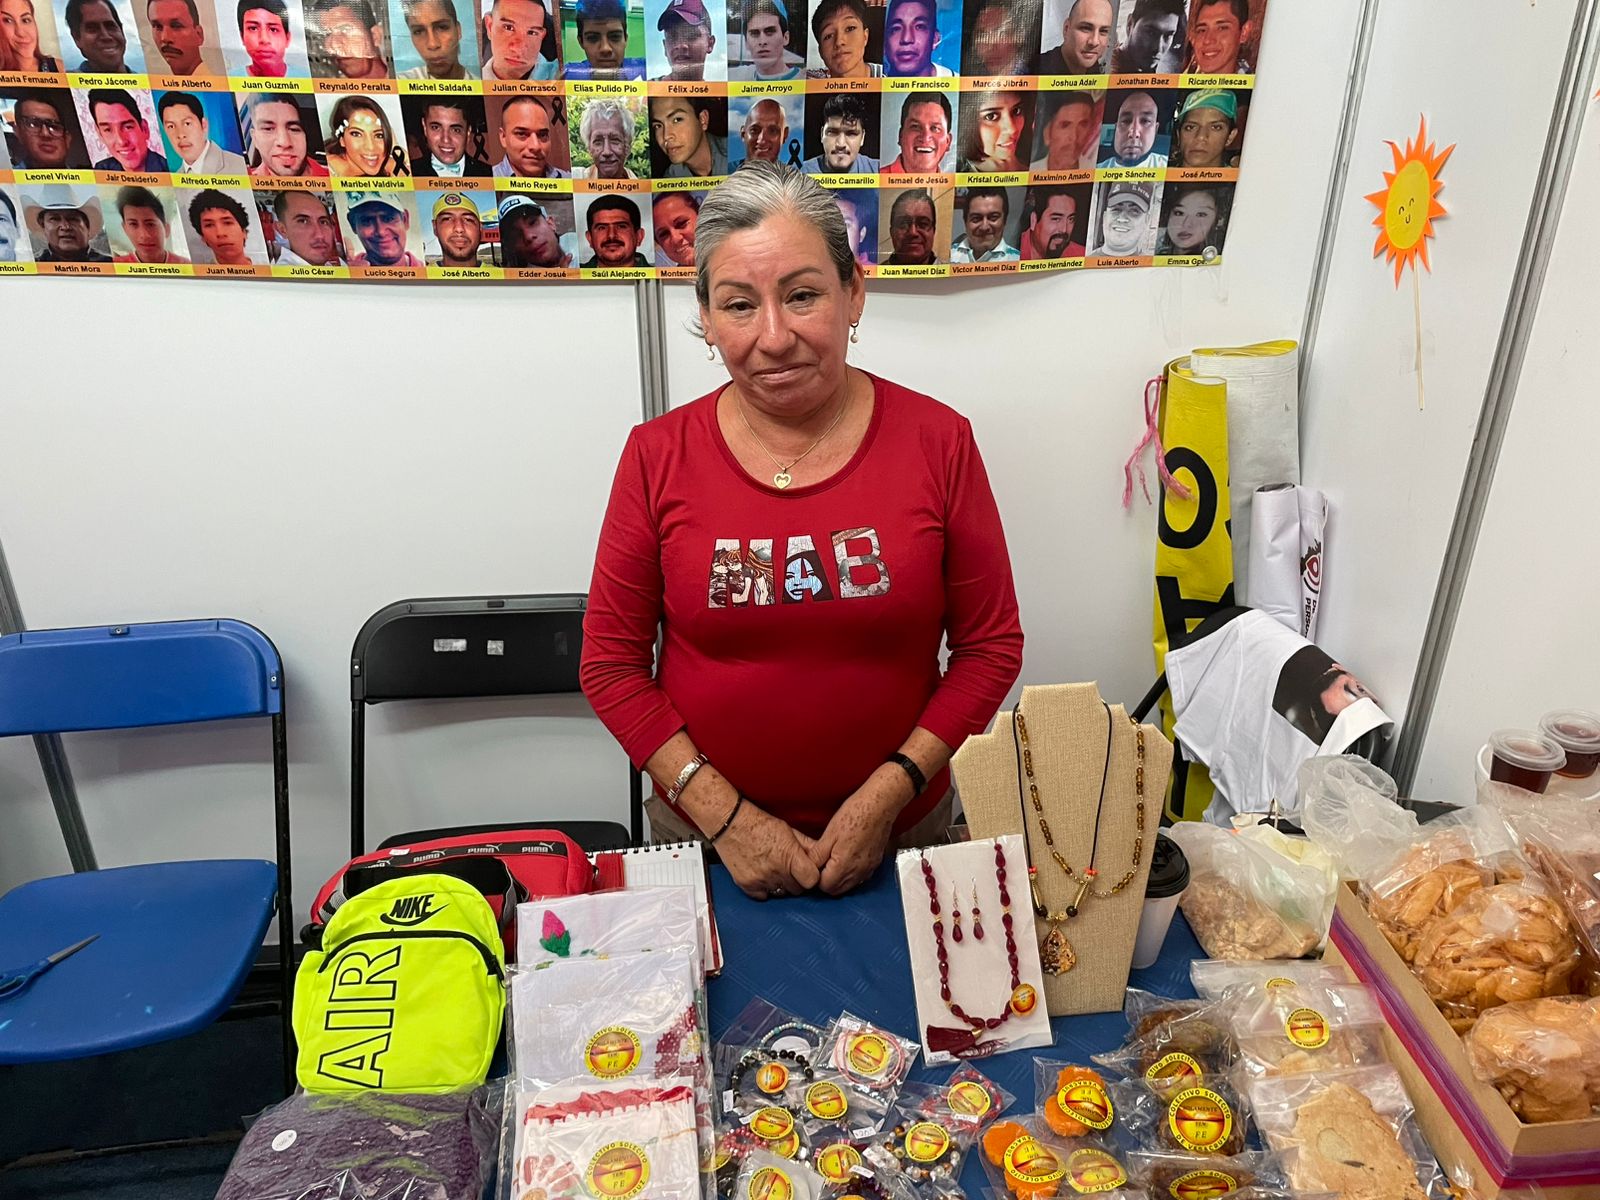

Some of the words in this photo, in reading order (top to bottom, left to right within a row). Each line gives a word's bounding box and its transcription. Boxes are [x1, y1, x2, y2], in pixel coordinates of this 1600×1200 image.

[23, 76, 58, 84] Fernanda
[105, 77, 137, 86] Jácome
[182, 80, 211, 88] Alberto
[1079, 78, 1097, 86] Adair
[265, 81, 299, 89] Guzmán
[320, 82, 359, 92] Reynaldo
[438, 83, 472, 91] Saldaña
[766, 84, 792, 92] Arroyo
[121, 175, 158, 183] Desiderio
[181, 177, 209, 185] Alfredo
[429, 180, 453, 188] Felipe
[455, 180, 478, 189] Diego
[534, 181, 557, 190] Reyes
[589, 182, 614, 190] Miguel
[388, 269, 416, 278] Segura
[610, 270, 646, 279] Alejandro
[708, 526, 891, 608] MAB
[413, 853, 440, 863] PUMA
[390, 894, 435, 918] NIKE
[317, 944, 402, 1088] AIR
[1165, 1054, 1195, 1065] SOLECITO
[1170, 1090, 1200, 1117] COLECTIVO
[1205, 1091, 1230, 1118] SOLECITO
[1188, 1136, 1226, 1151] VERACRUZ
[587, 1143, 616, 1176] COLECTIVO
[620, 1142, 648, 1163] SOLECITO
